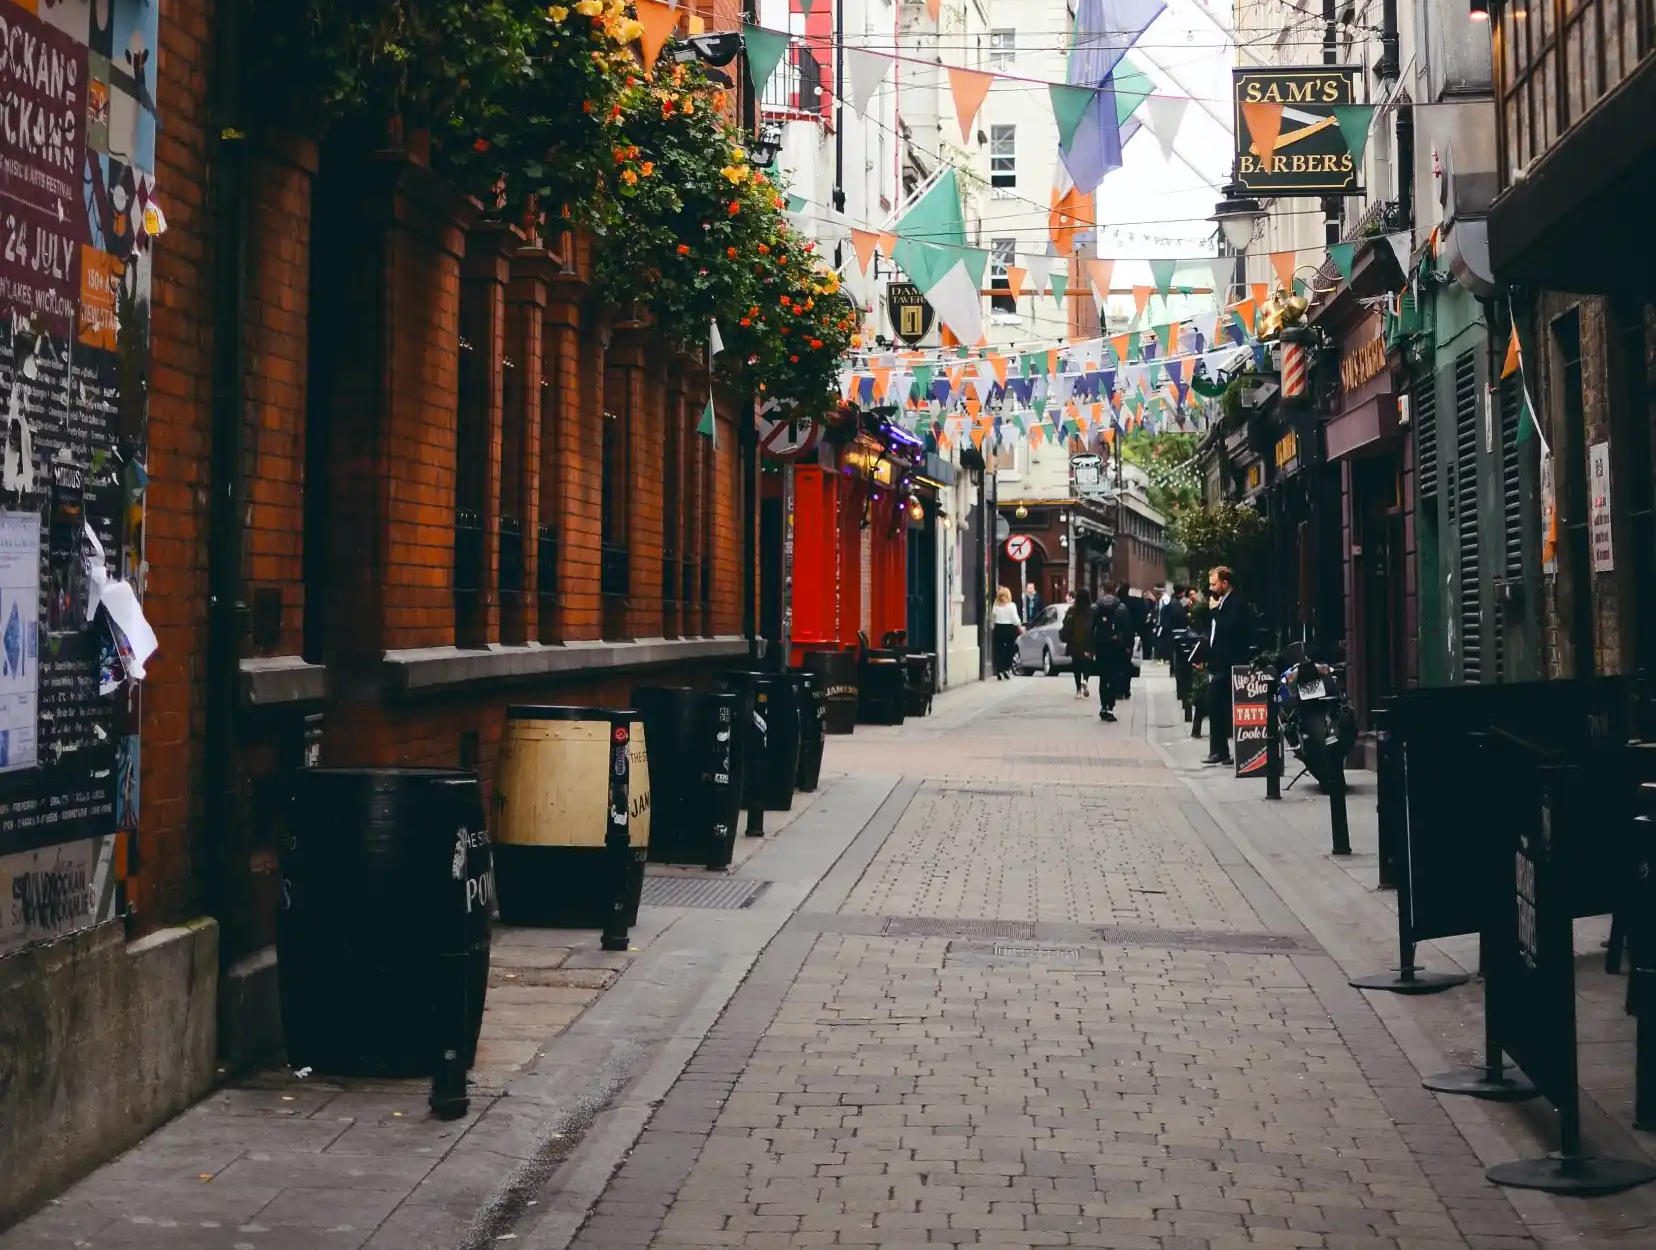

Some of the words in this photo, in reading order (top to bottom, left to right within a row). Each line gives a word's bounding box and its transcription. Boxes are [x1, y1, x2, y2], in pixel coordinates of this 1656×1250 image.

[1244, 78, 1339, 103] SAM'S
[46, 174, 74, 202] FESTIVAL
[31, 225, 75, 282] JULY
[35, 288, 75, 319] WICKLOW
[891, 286, 922, 296] DAM
[892, 295, 925, 304] TAVER
[1246, 680, 1268, 698] Sho
[1236, 707, 1268, 721] TATT
[465, 870, 494, 914] POW
